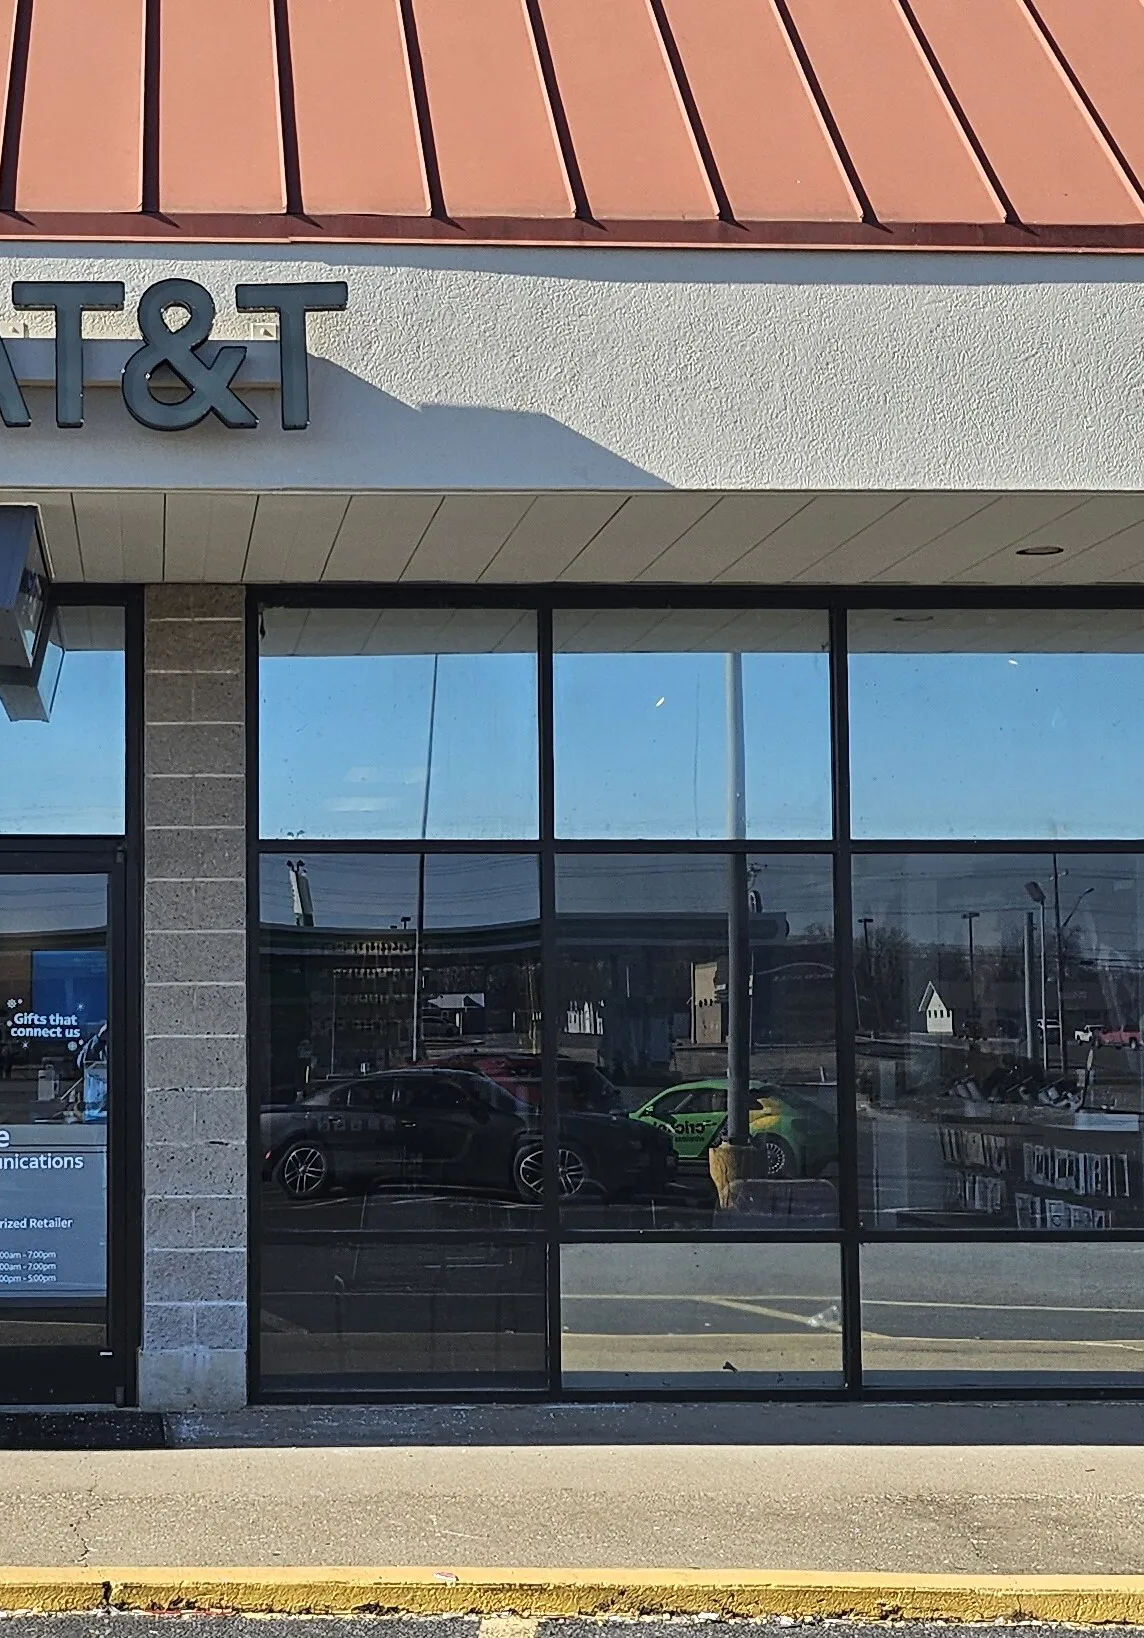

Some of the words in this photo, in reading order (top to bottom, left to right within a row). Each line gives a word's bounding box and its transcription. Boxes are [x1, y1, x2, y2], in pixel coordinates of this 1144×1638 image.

[13, 1012, 47, 1026] Gifts
[49, 1012, 78, 1026] that
[10, 1025, 62, 1038] connect
[64, 1027, 81, 1038] us
[29, 1217, 74, 1229] Retailer
[28, 1251, 56, 1260] 7:00pm
[28, 1262, 56, 1272] 7:00pm
[28, 1274, 56, 1284] 5:00pm
